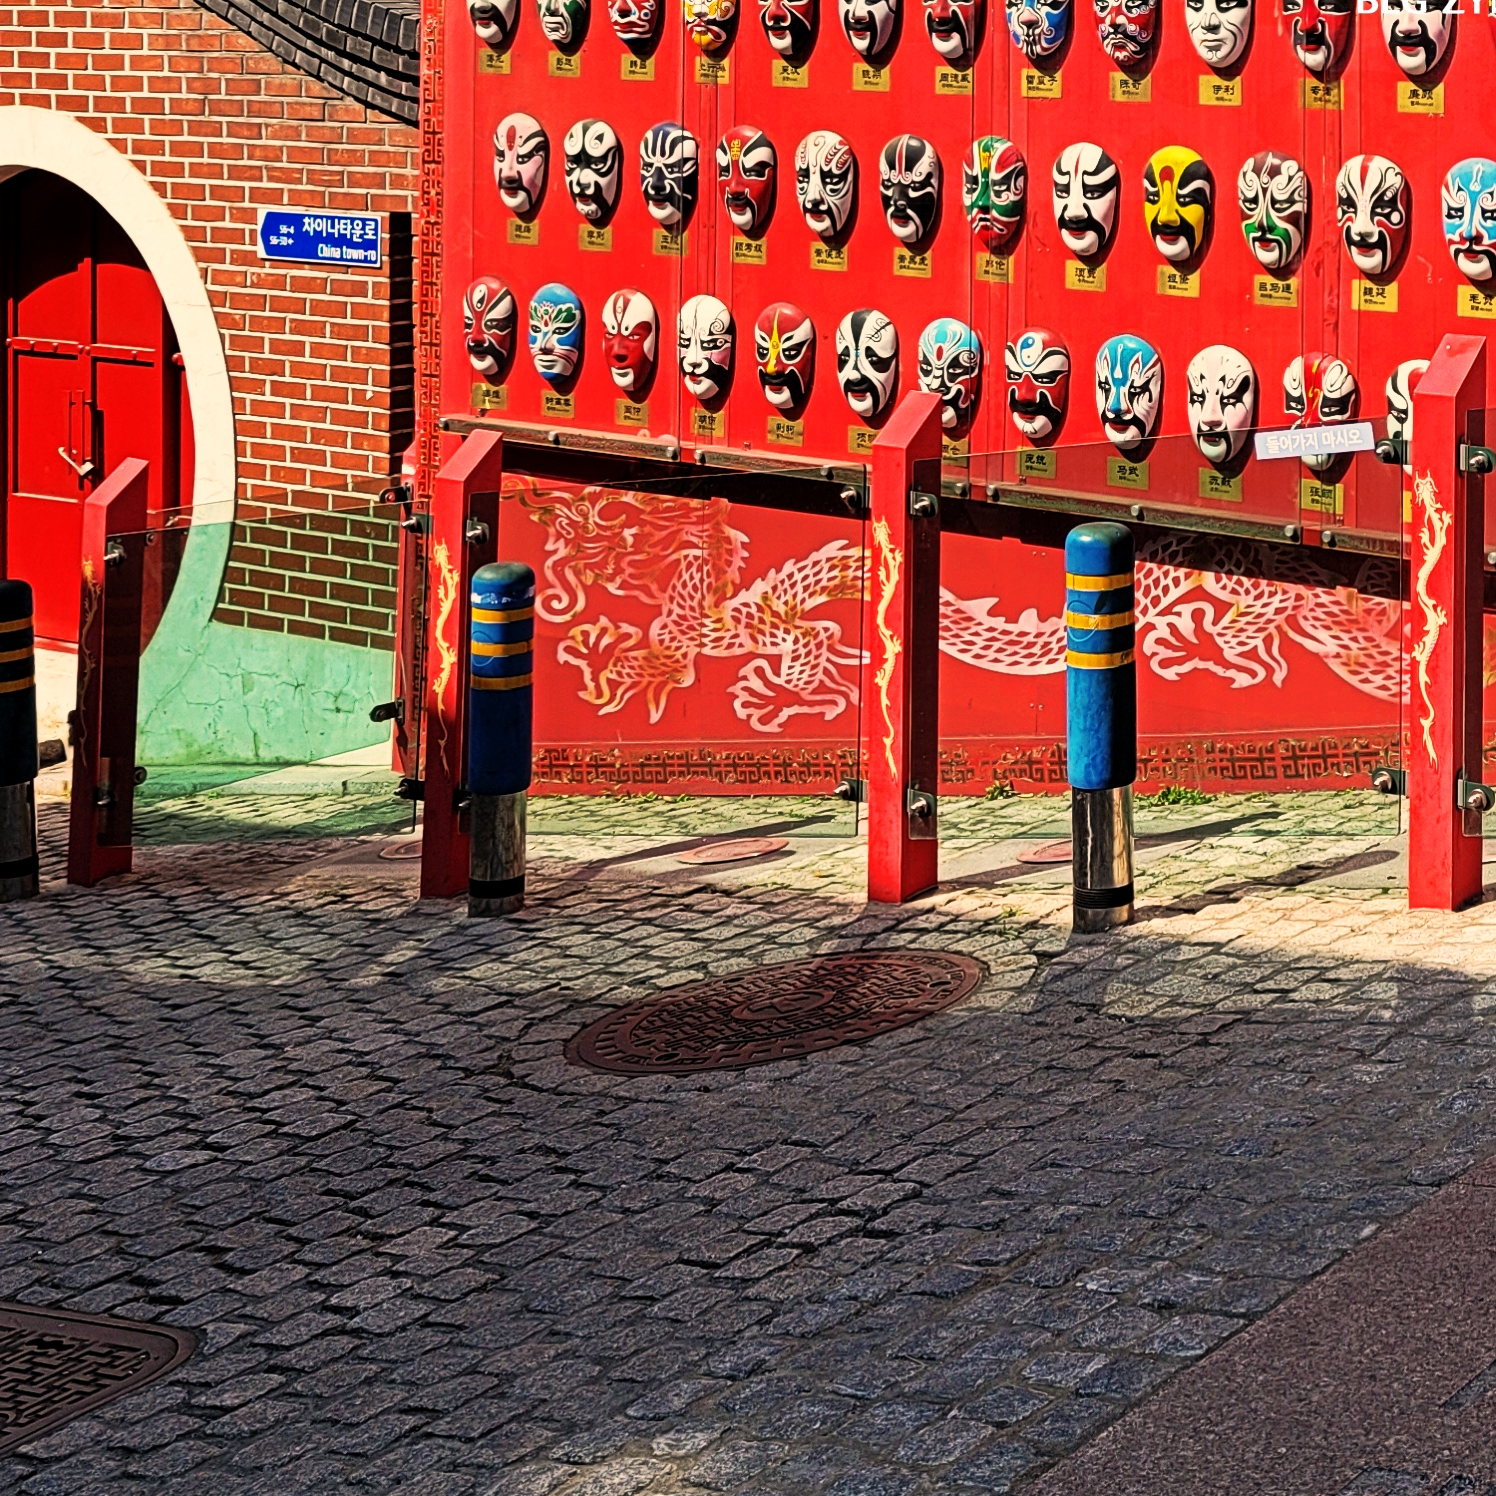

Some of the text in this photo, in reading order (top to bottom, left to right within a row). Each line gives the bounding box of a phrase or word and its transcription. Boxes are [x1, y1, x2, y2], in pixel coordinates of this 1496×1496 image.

[302, 216, 377, 242] 차이나타운로
[317, 243, 377, 261] China town-ro
[1265, 429, 1364, 454] 들어가지 마시오
